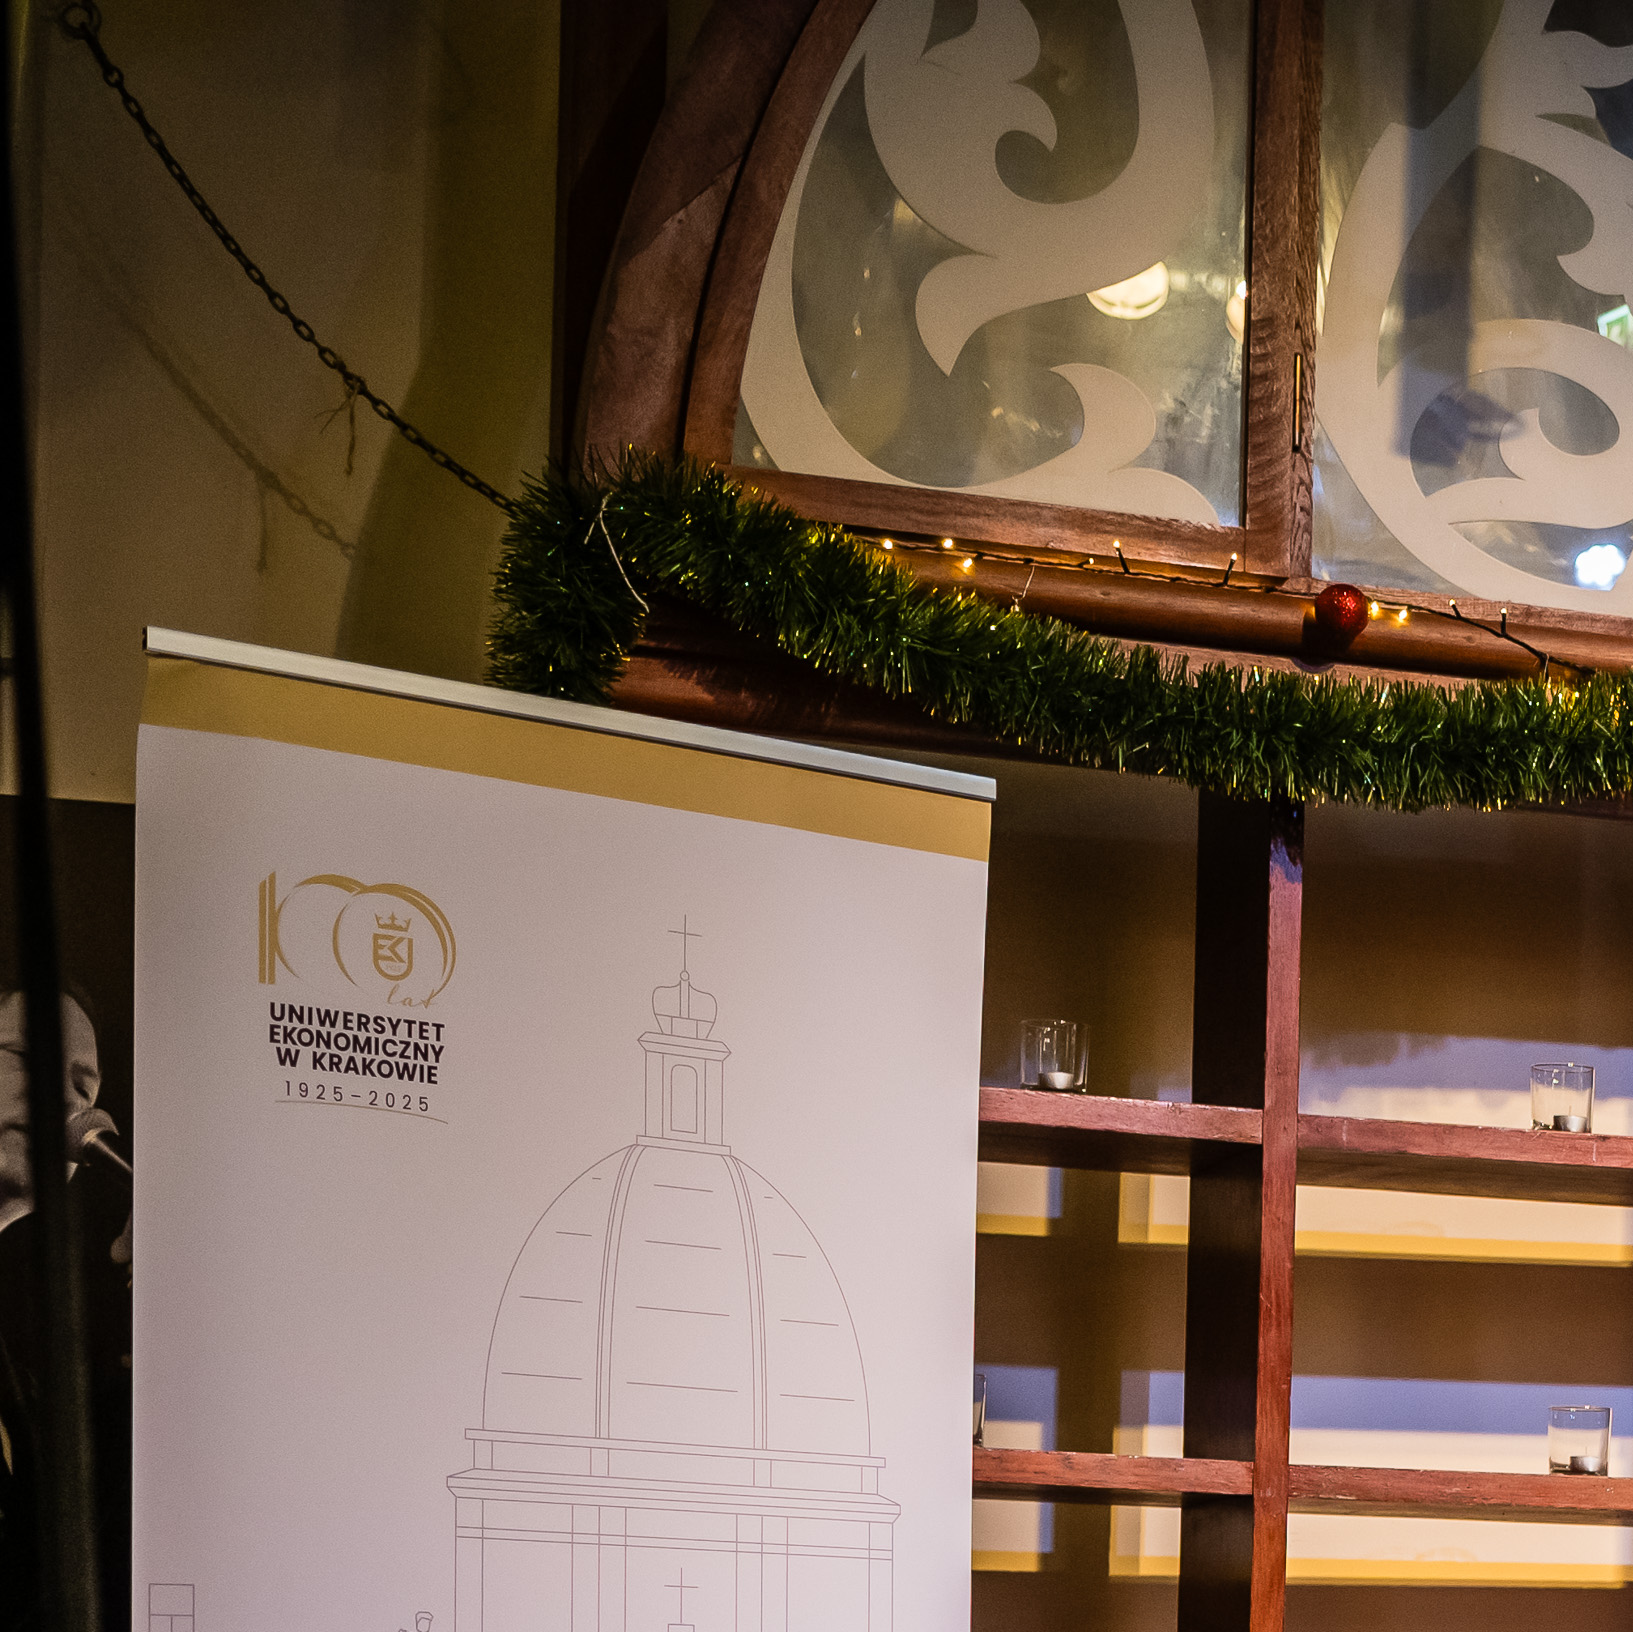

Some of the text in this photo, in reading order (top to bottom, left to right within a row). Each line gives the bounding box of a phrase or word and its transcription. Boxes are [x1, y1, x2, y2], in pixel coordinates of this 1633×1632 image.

[269, 1001, 446, 1042] UNIWERSYTET
[268, 1023, 446, 1064] EKONOMICZNY
[275, 1046, 439, 1085] W KRAKOWIE
